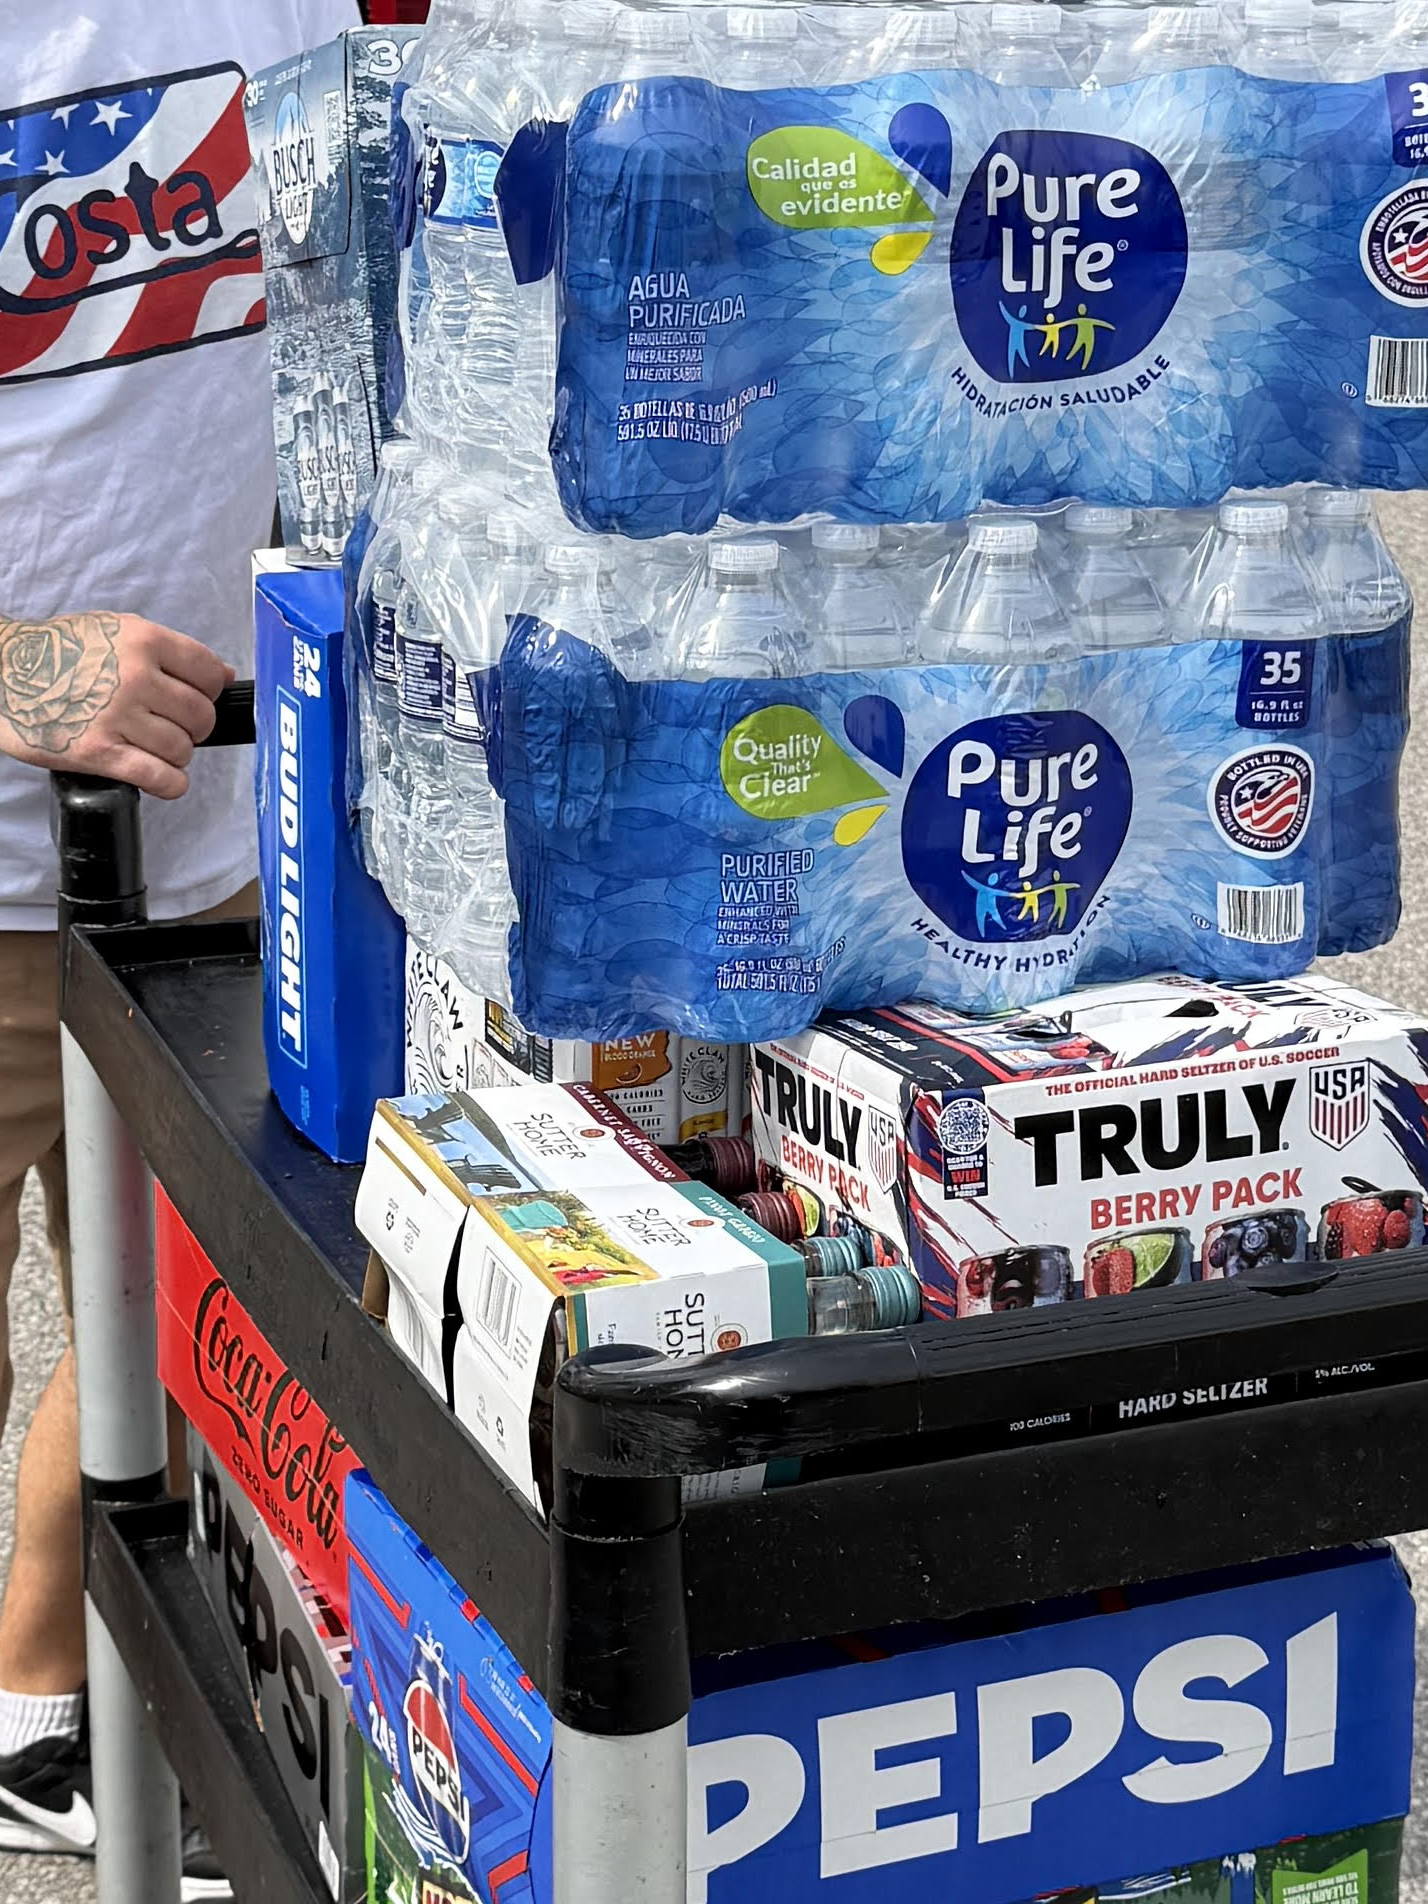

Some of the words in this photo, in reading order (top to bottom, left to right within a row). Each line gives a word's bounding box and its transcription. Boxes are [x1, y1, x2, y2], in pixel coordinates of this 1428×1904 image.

[273, 138, 317, 194] BUSCH
[751, 152, 857, 180] Calidad
[800, 179, 833, 193] que
[838, 178, 857, 189] es
[986, 152, 1140, 223] Pure
[628, 271, 690, 302] AGUA
[1001, 227, 1115, 310] Life
[628, 294, 747, 328] PURIFICADA
[951, 367, 1053, 419] HIDRATACIÓN
[1060, 354, 1171, 407] SALUDABLE
[303, 642, 322, 698] 24
[1259, 650, 1302, 685] 35
[1253, 712, 1301, 722] BOTTLES
[733, 734, 822, 765] Quality
[770, 758, 812, 776] That's
[947, 739, 1099, 805] Pure
[278, 700, 301, 849] BUD
[738, 771, 812, 800] Clear
[721, 848, 815, 879] PURIFIED
[962, 804, 1085, 879] Life
[720, 878, 799, 904] WATER
[278, 865, 302, 1053] LIGHT
[726, 933, 758, 945] CRISP
[910, 917, 1008, 971] HEALTHY
[604, 1033, 656, 1052] NEW
[1046, 1081, 1073, 1097] THE
[1074, 1074, 1138, 1095] OFFICIAL
[1139, 1068, 1178, 1085] HARD
[1181, 1061, 1237, 1079] SELTZER
[1238, 1058, 1257, 1071] OF
[1258, 1051, 1283, 1068] U.S.
[1285, 1046, 1341, 1064] SOCCER
[1313, 1065, 1366, 1101] USA
[572, 1084, 622, 1131] CABERNET
[754, 1046, 863, 1170] TRULY
[870, 1109, 896, 1146] USA
[513, 1120, 557, 1158] HOME
[530, 1111, 587, 1161] SUTTER
[1014, 1077, 1297, 1189] TRULY
[780, 1134, 824, 1185] BERRY
[828, 1162, 872, 1213] PACK
[1089, 1179, 1197, 1231] BERRY
[1212, 1167, 1303, 1212] PACK
[618, 1214, 662, 1246] HOME
[636, 1207, 692, 1248] SUTTER
[684, 1292, 705, 1356] SUTT
[192, 1277, 346, 1550] Coca-Cola
[1118, 1391, 1177, 1419] HARD
[1182, 1376, 1270, 1406] SELTZER
[232, 1444, 261, 1496] ZERO
[263, 1487, 304, 1550] SUGAR
[368, 1700, 393, 1765] 24
[412, 1724, 466, 1823] PEPSI
[1312, 1884, 1344, 1904] LEARN
[1345, 1882, 1359, 1896] TO
